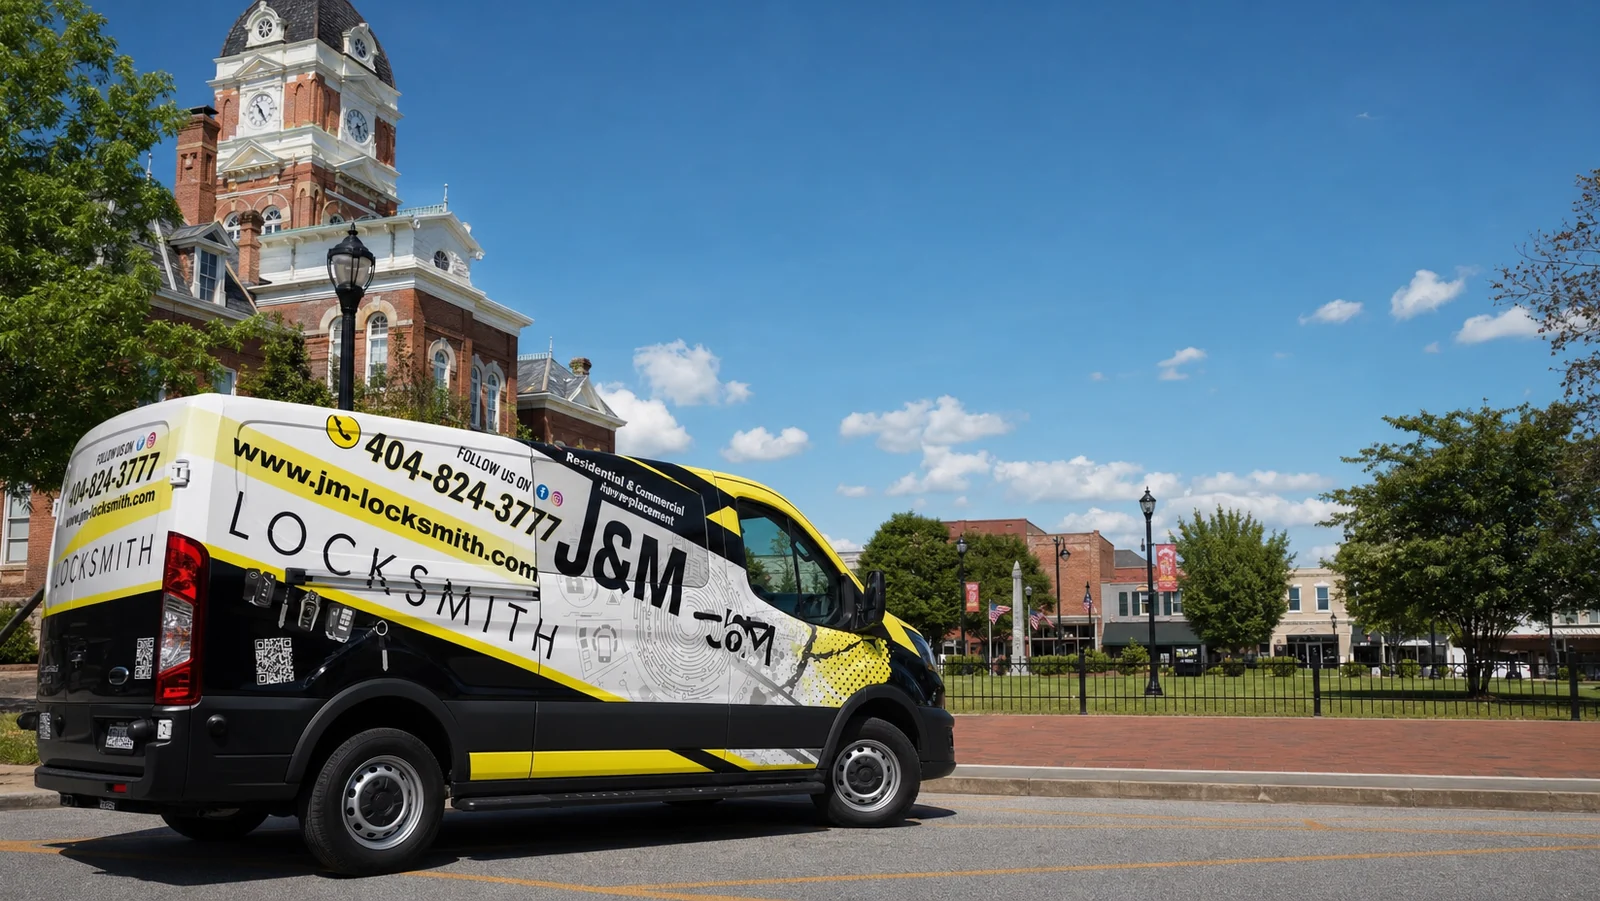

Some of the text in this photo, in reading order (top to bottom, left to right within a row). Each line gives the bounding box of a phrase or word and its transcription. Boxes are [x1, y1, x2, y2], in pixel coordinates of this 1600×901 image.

[69, 452, 160, 508] 404-824-3777
[96, 447, 116, 466] FOLLOW
[365, 432, 562, 542] 404-824-3777
[457, 446, 532, 492] FOLLOW US ON
[566, 452, 625, 487] Residential
[626, 480, 634, 491] &
[635, 484, 685, 516] Commercial
[233, 438, 538, 582] www.jm-locksmith.com
[554, 480, 688, 617] J&M
[229, 491, 558, 660] LOCKSMITH
